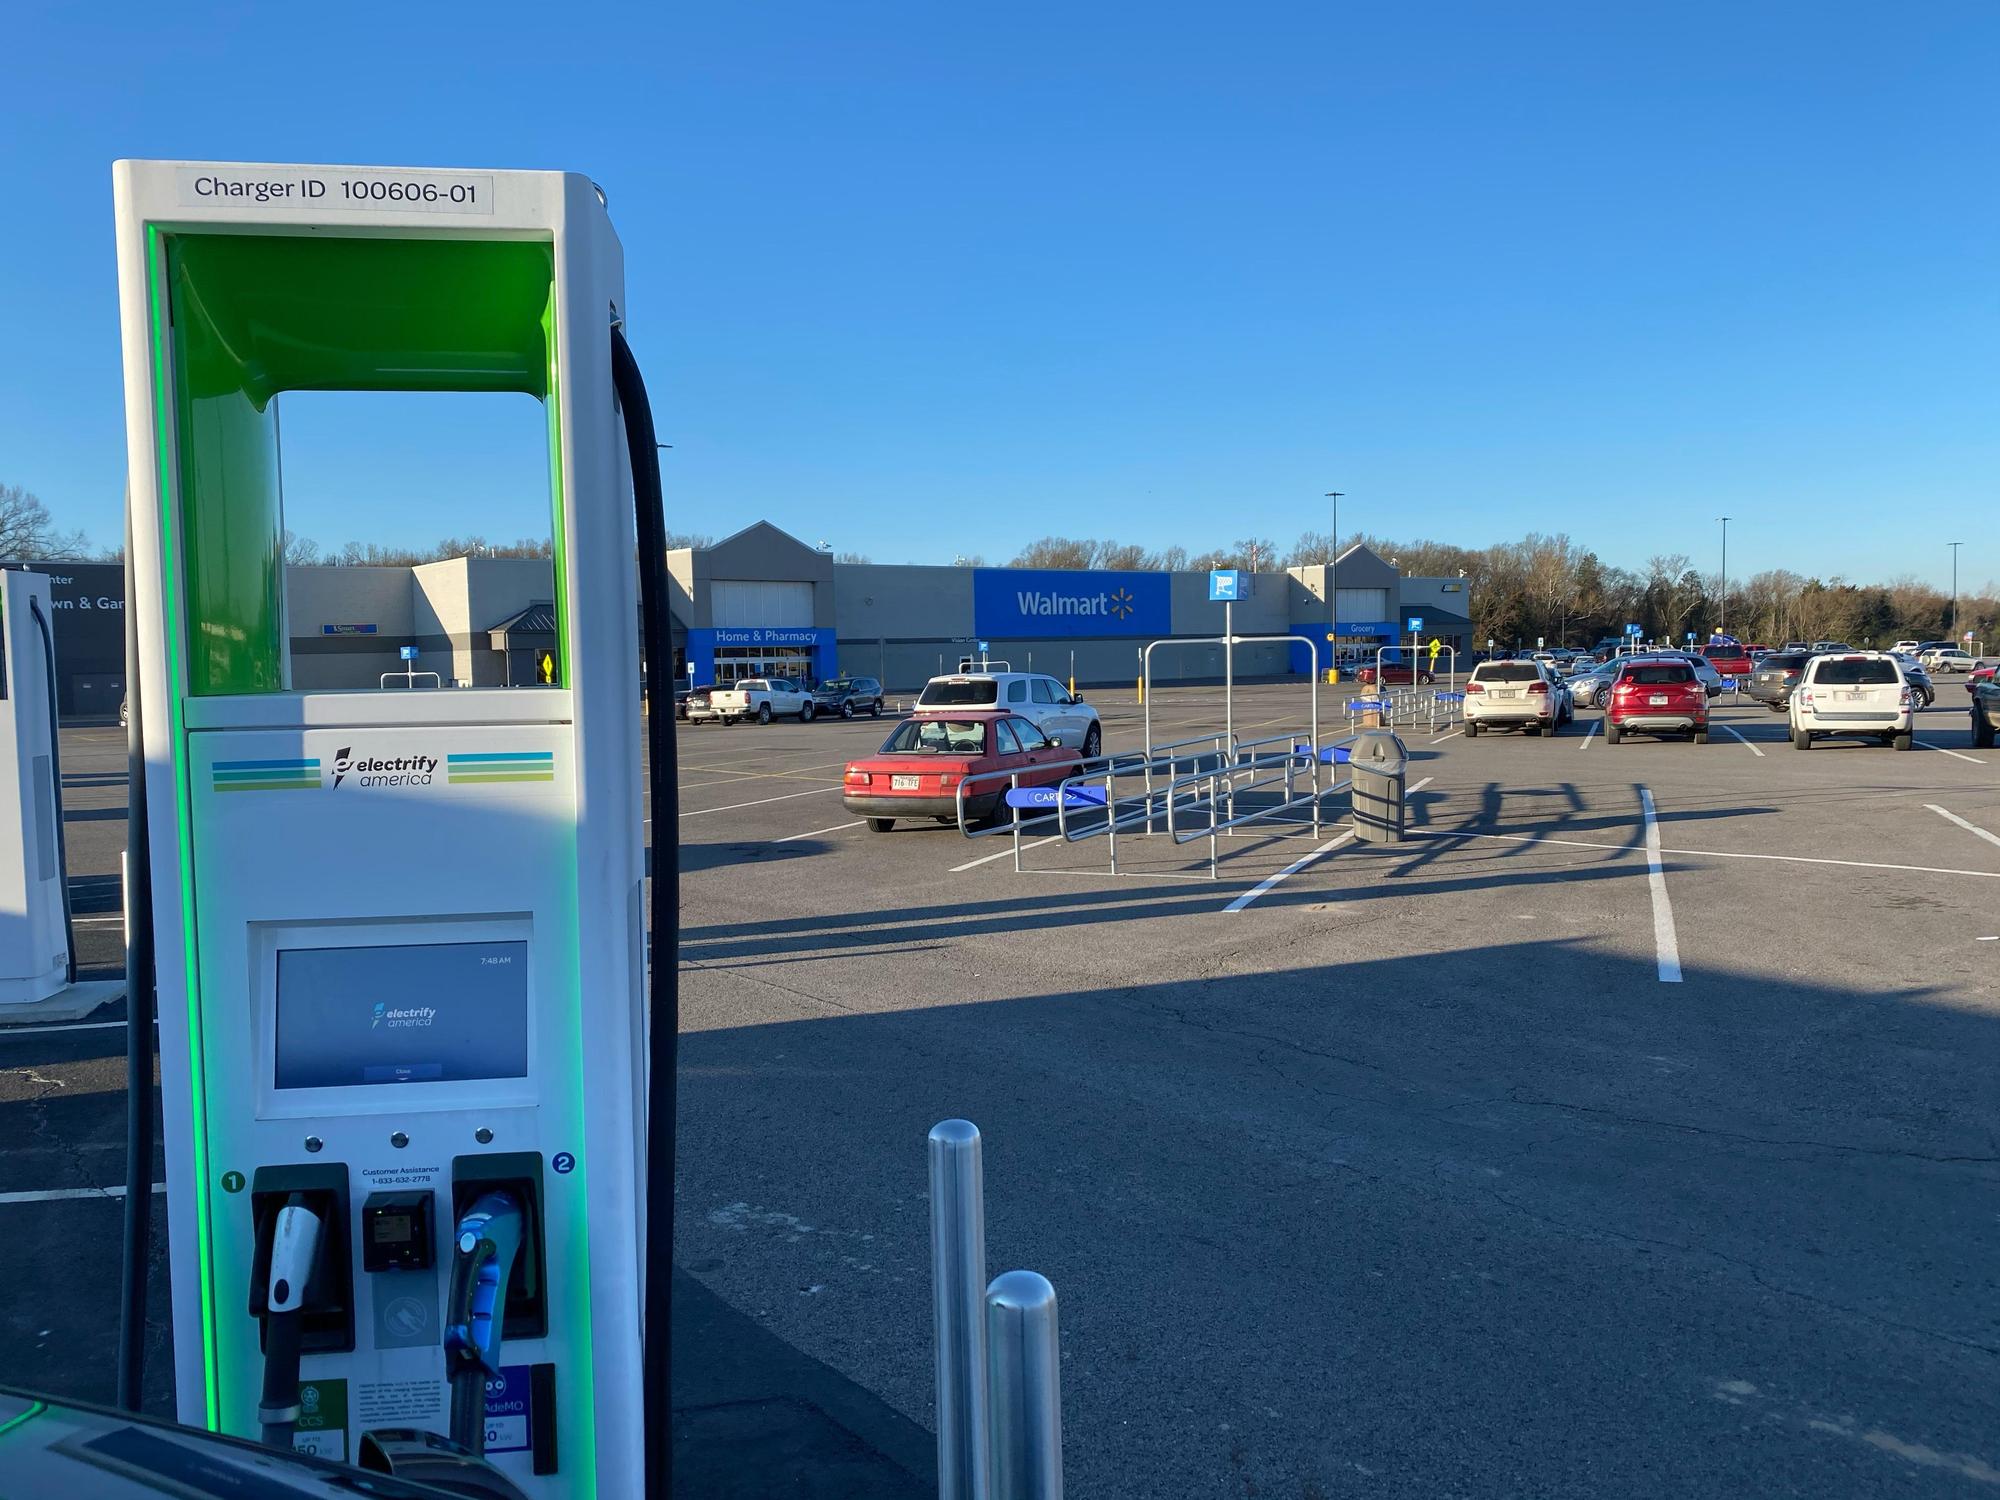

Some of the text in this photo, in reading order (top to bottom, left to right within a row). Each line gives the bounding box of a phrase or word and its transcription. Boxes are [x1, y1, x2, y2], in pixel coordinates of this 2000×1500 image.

[194, 176, 477, 204] Charger ID 100606-01
[49, 575, 73, 585] nter
[51, 596, 125, 610] wn & Gar
[1017, 591, 1108, 616] Walmart
[1350, 623, 1376, 636] Grocery
[716, 630, 818, 645] Home & Pharmacy
[356, 755, 438, 773] electrify
[359, 773, 432, 788] america
[1034, 792, 1060, 803] CART
[480, 957, 498, 965] 7:48
[387, 1007, 436, 1019] electrify
[387, 1016, 432, 1028] america
[557, 1156, 570, 1171] 2
[362, 1166, 440, 1176] Customer Assistance
[228, 1175, 238, 1189] 1
[484, 1400, 524, 1413] AdeMO
[299, 1415, 324, 1428] CCS
